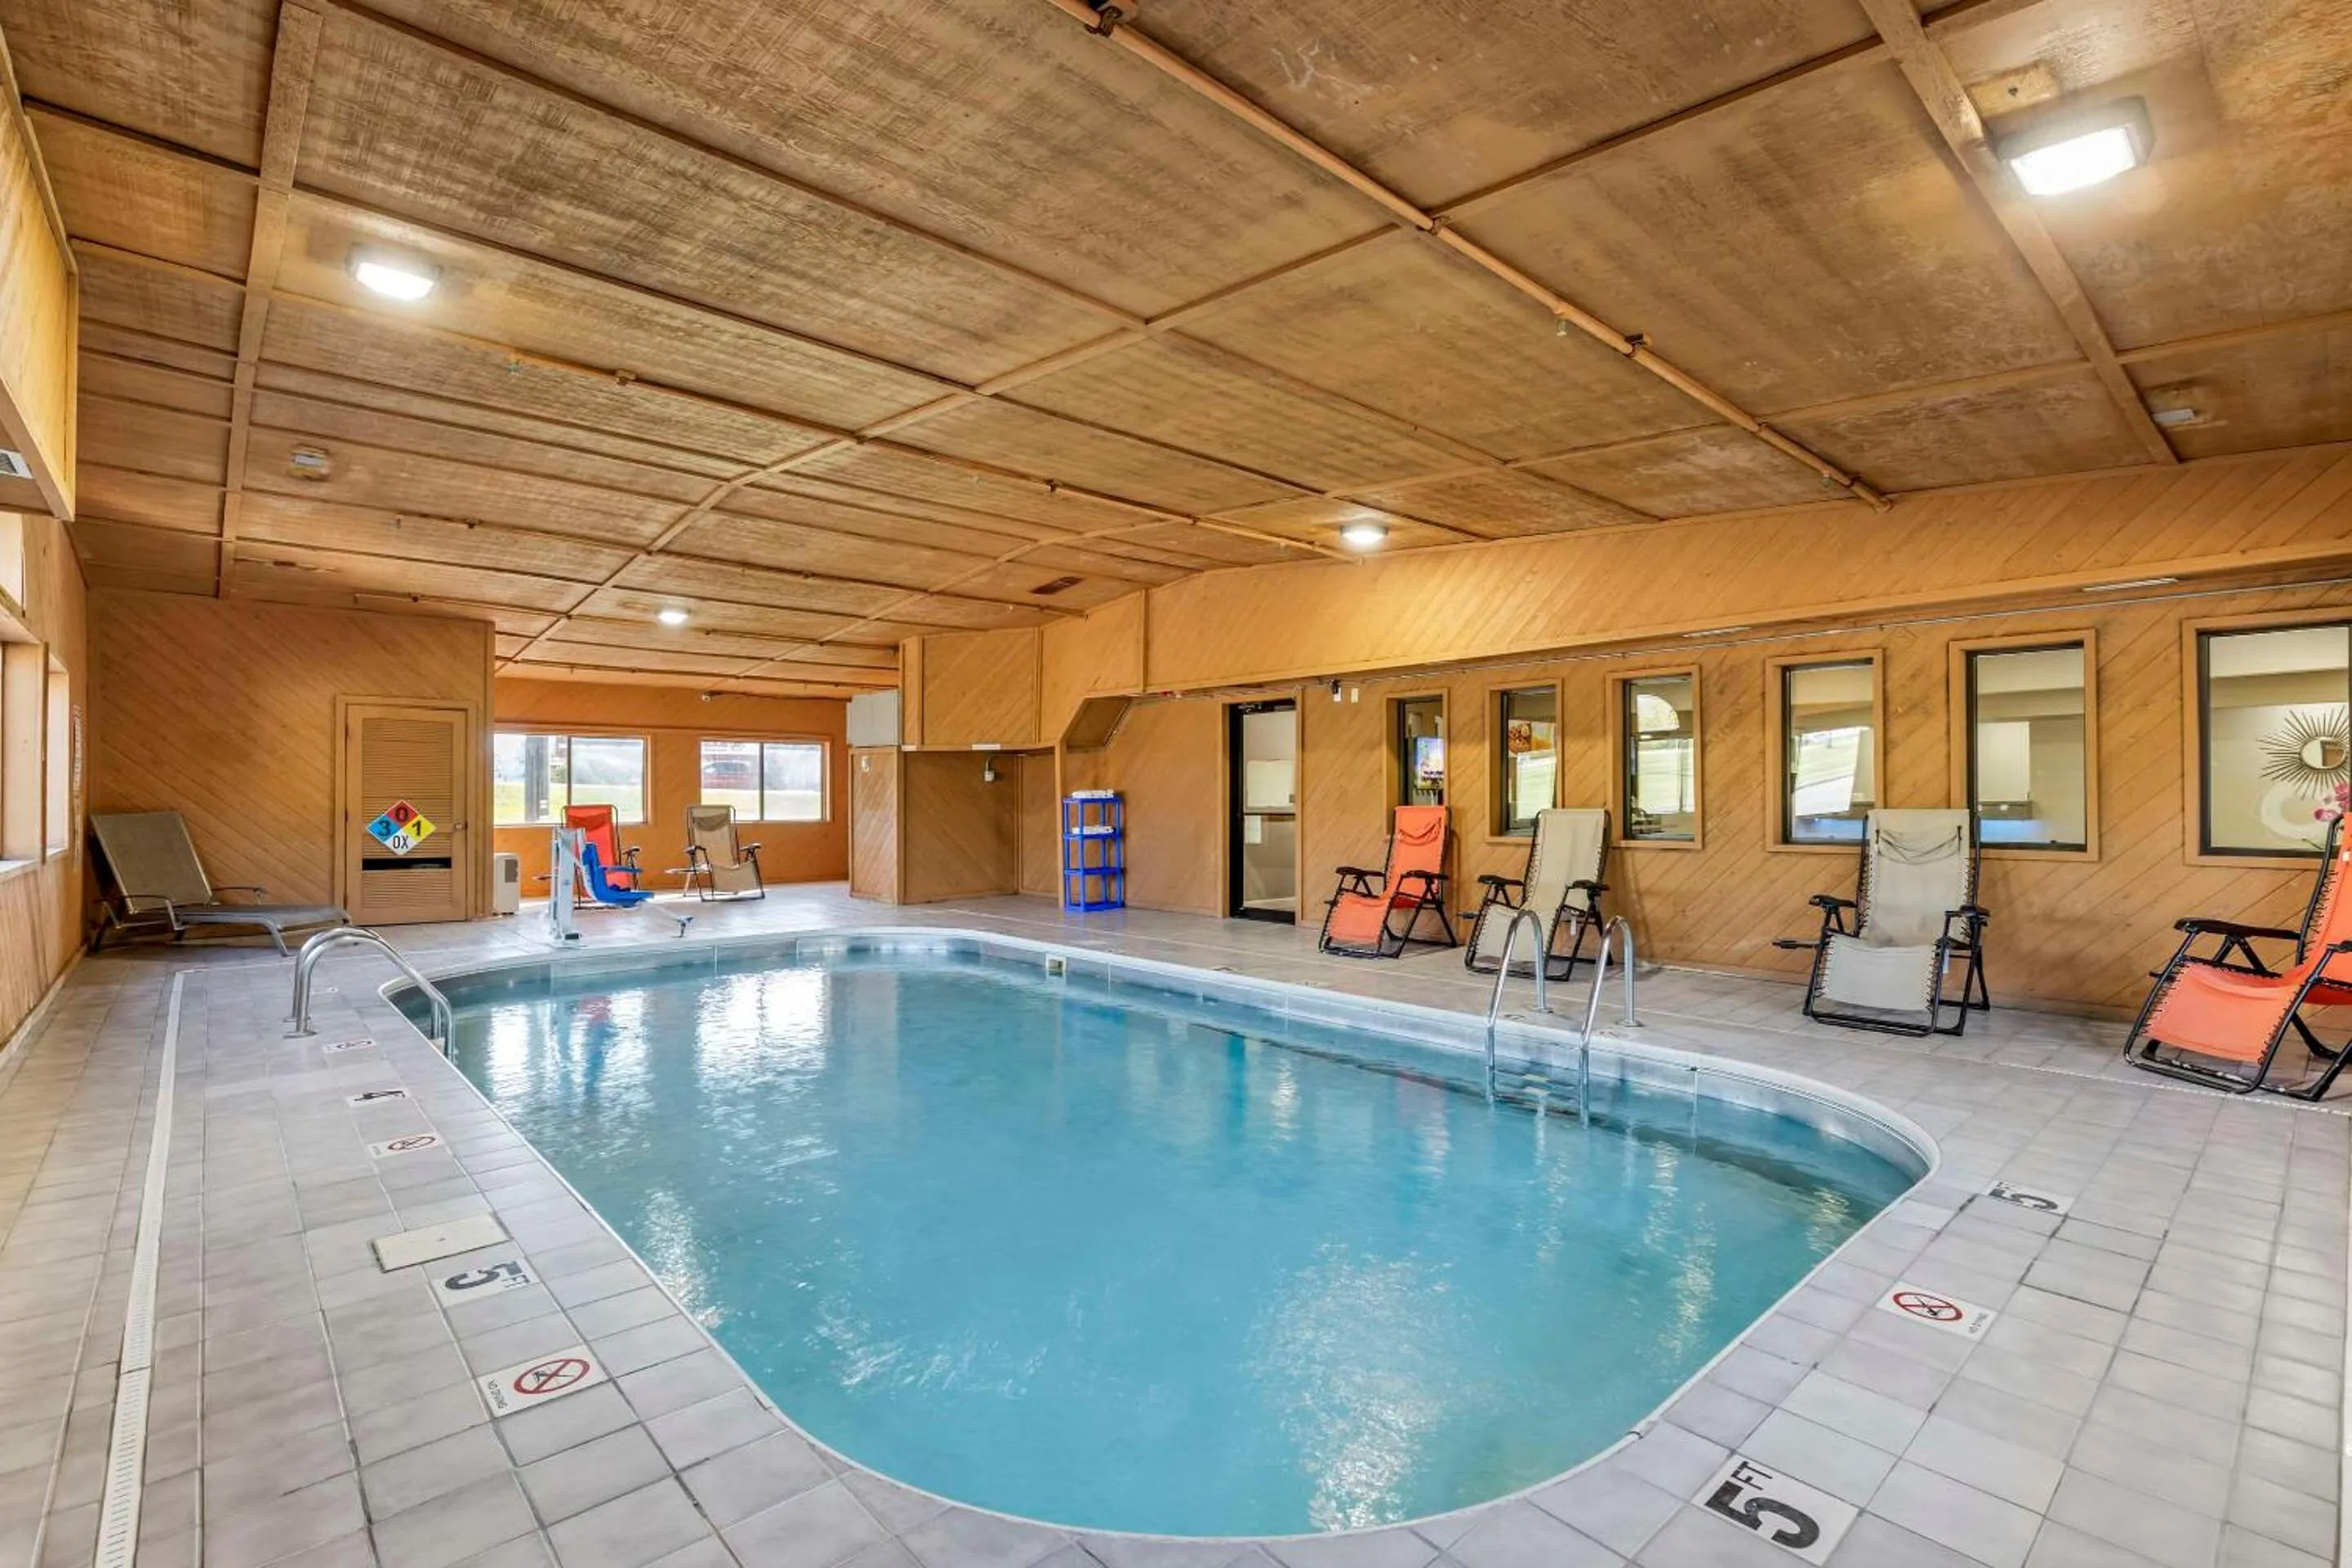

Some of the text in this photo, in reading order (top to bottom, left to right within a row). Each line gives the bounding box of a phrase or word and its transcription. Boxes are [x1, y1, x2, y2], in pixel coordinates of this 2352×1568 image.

[394, 807, 408, 822] 0
[378, 820, 392, 836] 3
[412, 820, 422, 836] 1
[393, 835, 408, 849] OX
[1989, 1189, 2058, 1209] 5
[444, 1261, 523, 1290] 5
[1704, 1460, 1820, 1548] 5 FT
